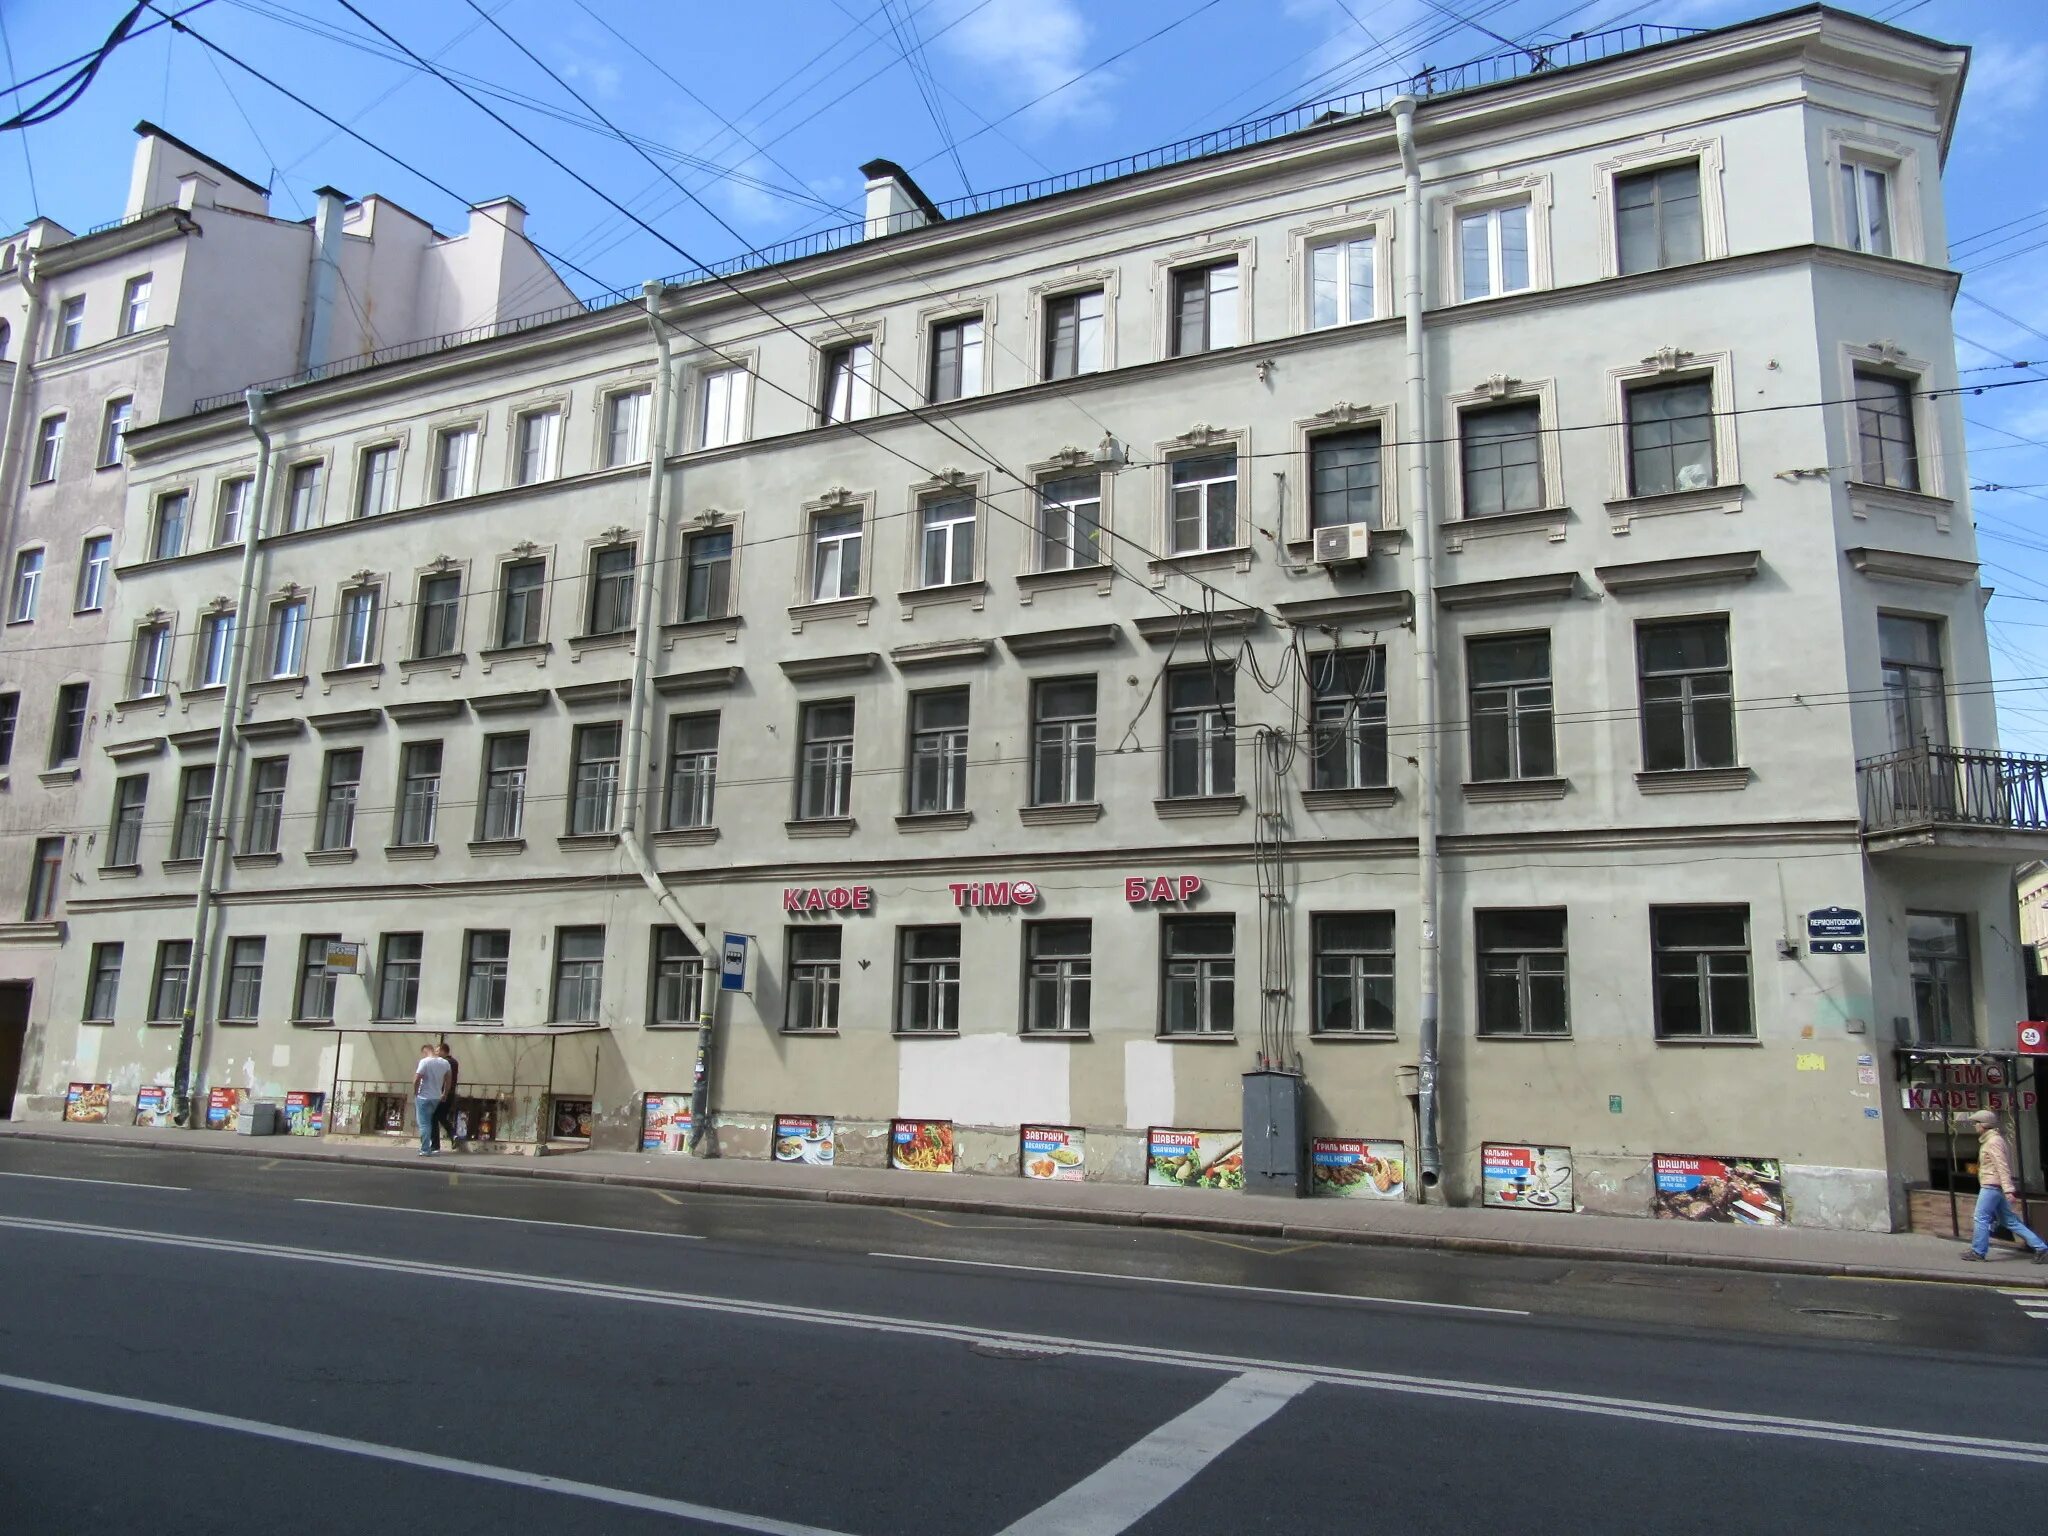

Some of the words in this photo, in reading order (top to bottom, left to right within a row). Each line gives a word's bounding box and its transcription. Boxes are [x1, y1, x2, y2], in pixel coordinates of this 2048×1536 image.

[783, 886, 869, 910] КАФЕ
[1125, 875, 1200, 902] БАР
[1810, 917, 1861, 926] ЛЕРМОНТОВСКИЙ
[1832, 943, 1843, 952] 49
[896, 1123, 917, 1132] ПАСТА
[1025, 1131, 1063, 1142] ЗАВТРАКИ
[1152, 1134, 1192, 1144] ШАВЕРМА
[1025, 1142, 1055, 1150] BREAKFAST
[1316, 1143, 1338, 1151] ГРИЛЬ
[1340, 1144, 1360, 1152] МЕНЮ
[1485, 1157, 1510, 1166] ЧАЙНИК
[1657, 1160, 1699, 1169] ШАШЛЫК
